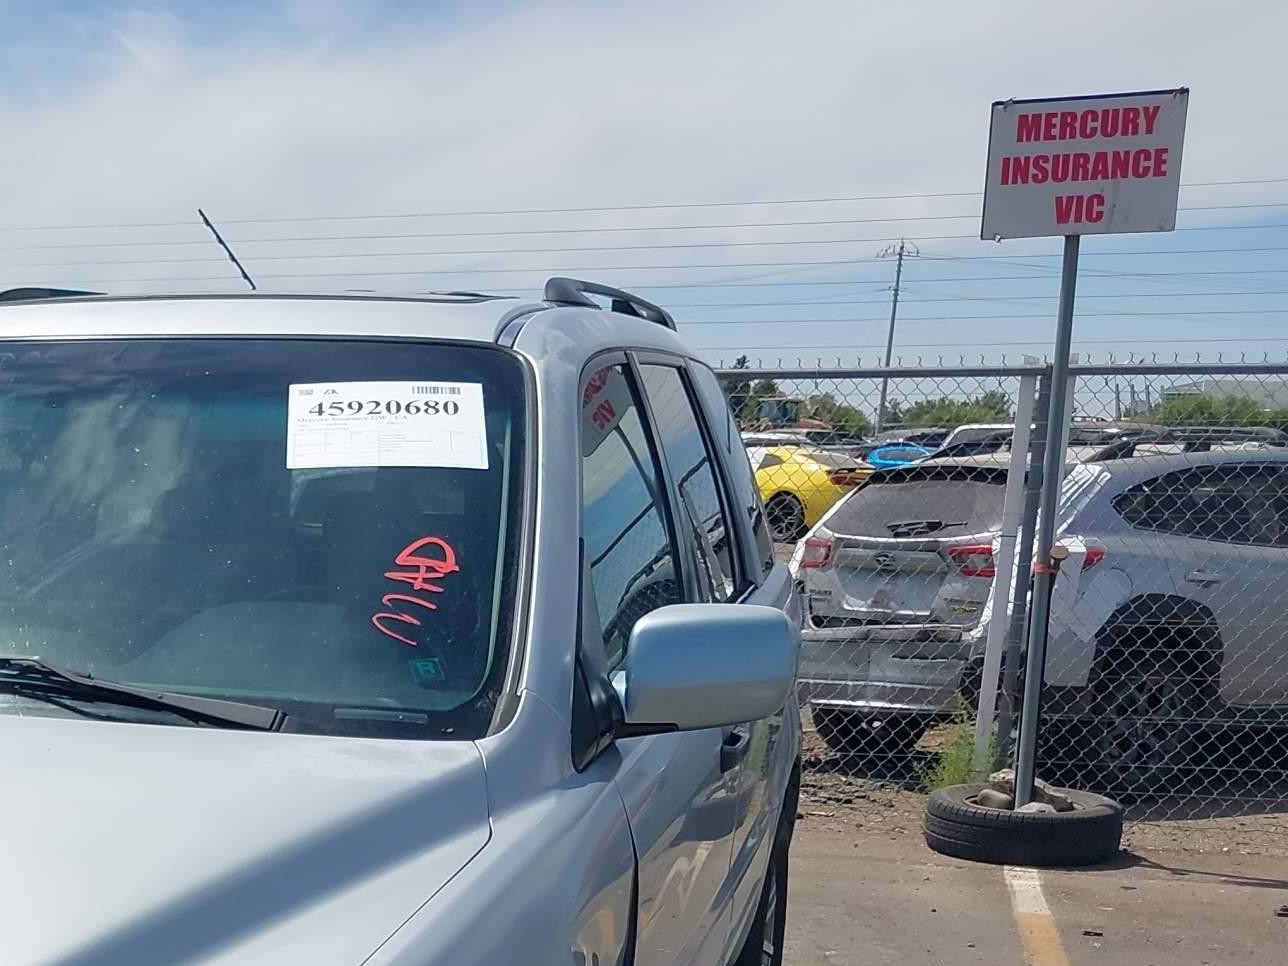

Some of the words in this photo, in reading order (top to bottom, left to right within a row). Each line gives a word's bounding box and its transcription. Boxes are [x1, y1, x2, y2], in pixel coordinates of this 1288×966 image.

[1016, 106, 1161, 143] MERCURY
[1000, 148, 1169, 186] INSURANCE
[1054, 193, 1105, 225] VIC
[309, 400, 460, 417] 45920680
